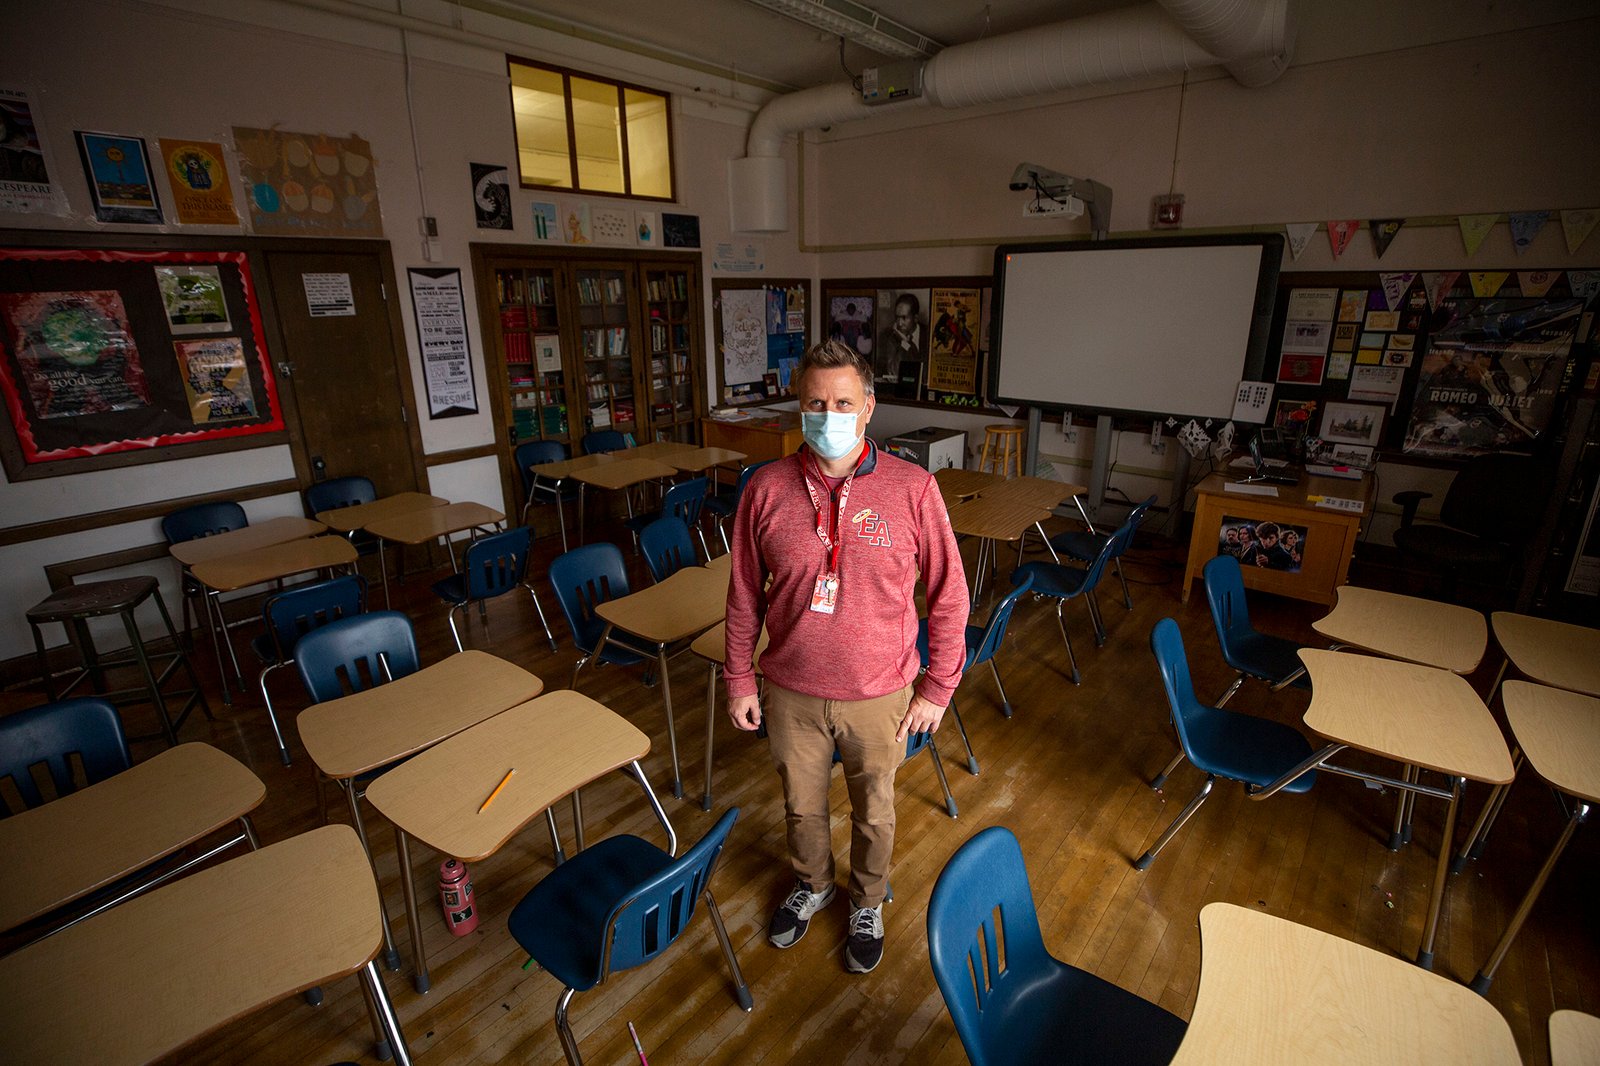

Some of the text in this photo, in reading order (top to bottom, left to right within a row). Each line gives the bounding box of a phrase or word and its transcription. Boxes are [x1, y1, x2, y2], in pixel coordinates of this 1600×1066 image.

[50, 370, 62, 379] all
[48, 374, 87, 391] good
[432, 391, 472, 405] AWESOME
[1430, 390, 1478, 404] ROMEO
[858, 513, 892, 547] EA
